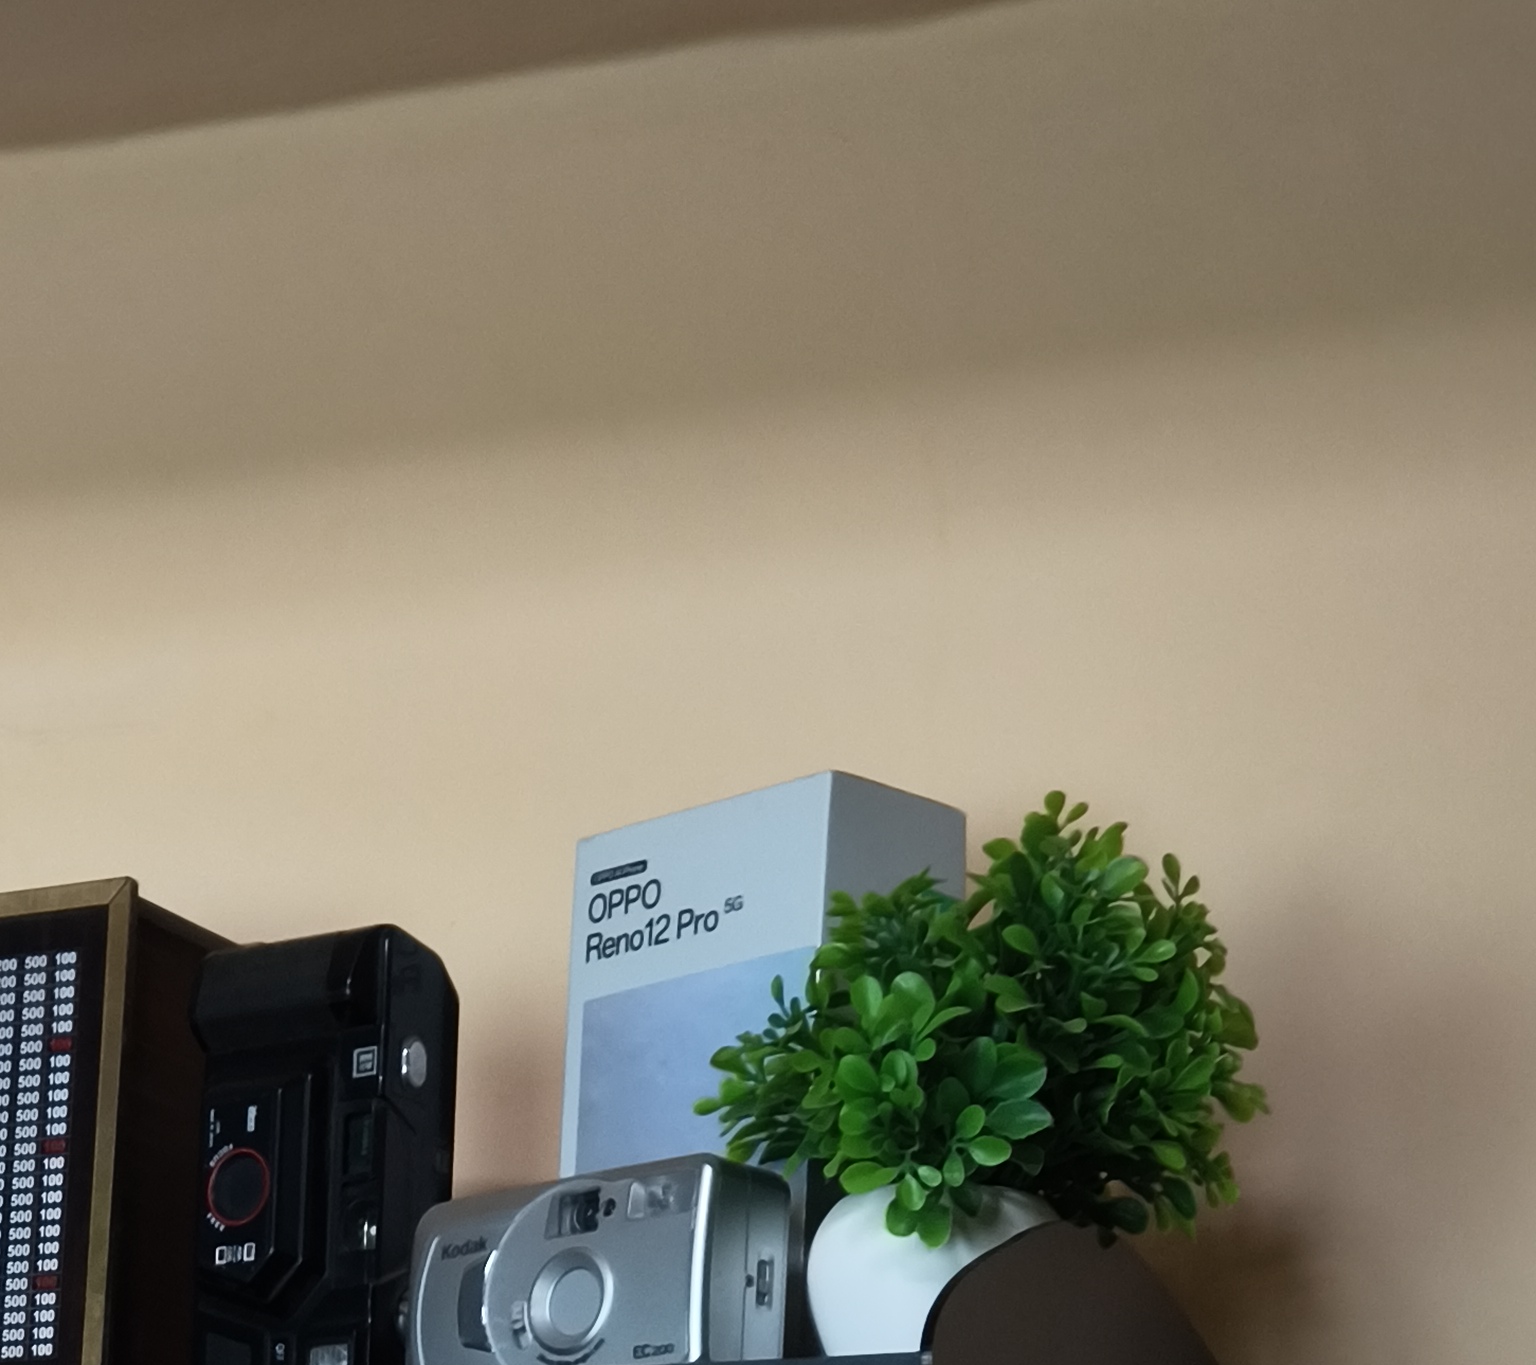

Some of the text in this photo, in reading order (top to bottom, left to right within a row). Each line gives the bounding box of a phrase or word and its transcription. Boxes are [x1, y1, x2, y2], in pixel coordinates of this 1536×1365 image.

[588, 879, 661, 923] OPPO
[586, 895, 743, 964] Reno12 Pro 5G
[24, 954, 48, 970] 500
[55, 951, 77, 966] 100
[23, 971, 47, 987] 500
[54, 968, 76, 982] 100
[22, 988, 46, 1004] 500
[53, 985, 75, 1000] 100
[21, 1005, 45, 1021] 500
[52, 1002, 74, 1017] 100
[14, 1124, 38, 1139] 500
[45, 1122, 67, 1136] 100
[8, 1226, 32, 1241] 500
[38, 1224, 61, 1238] 100
[441, 1237, 488, 1260] Kodak
[0, 1345, 24, 1359] 500
[31, 1343, 53, 1356] 100
